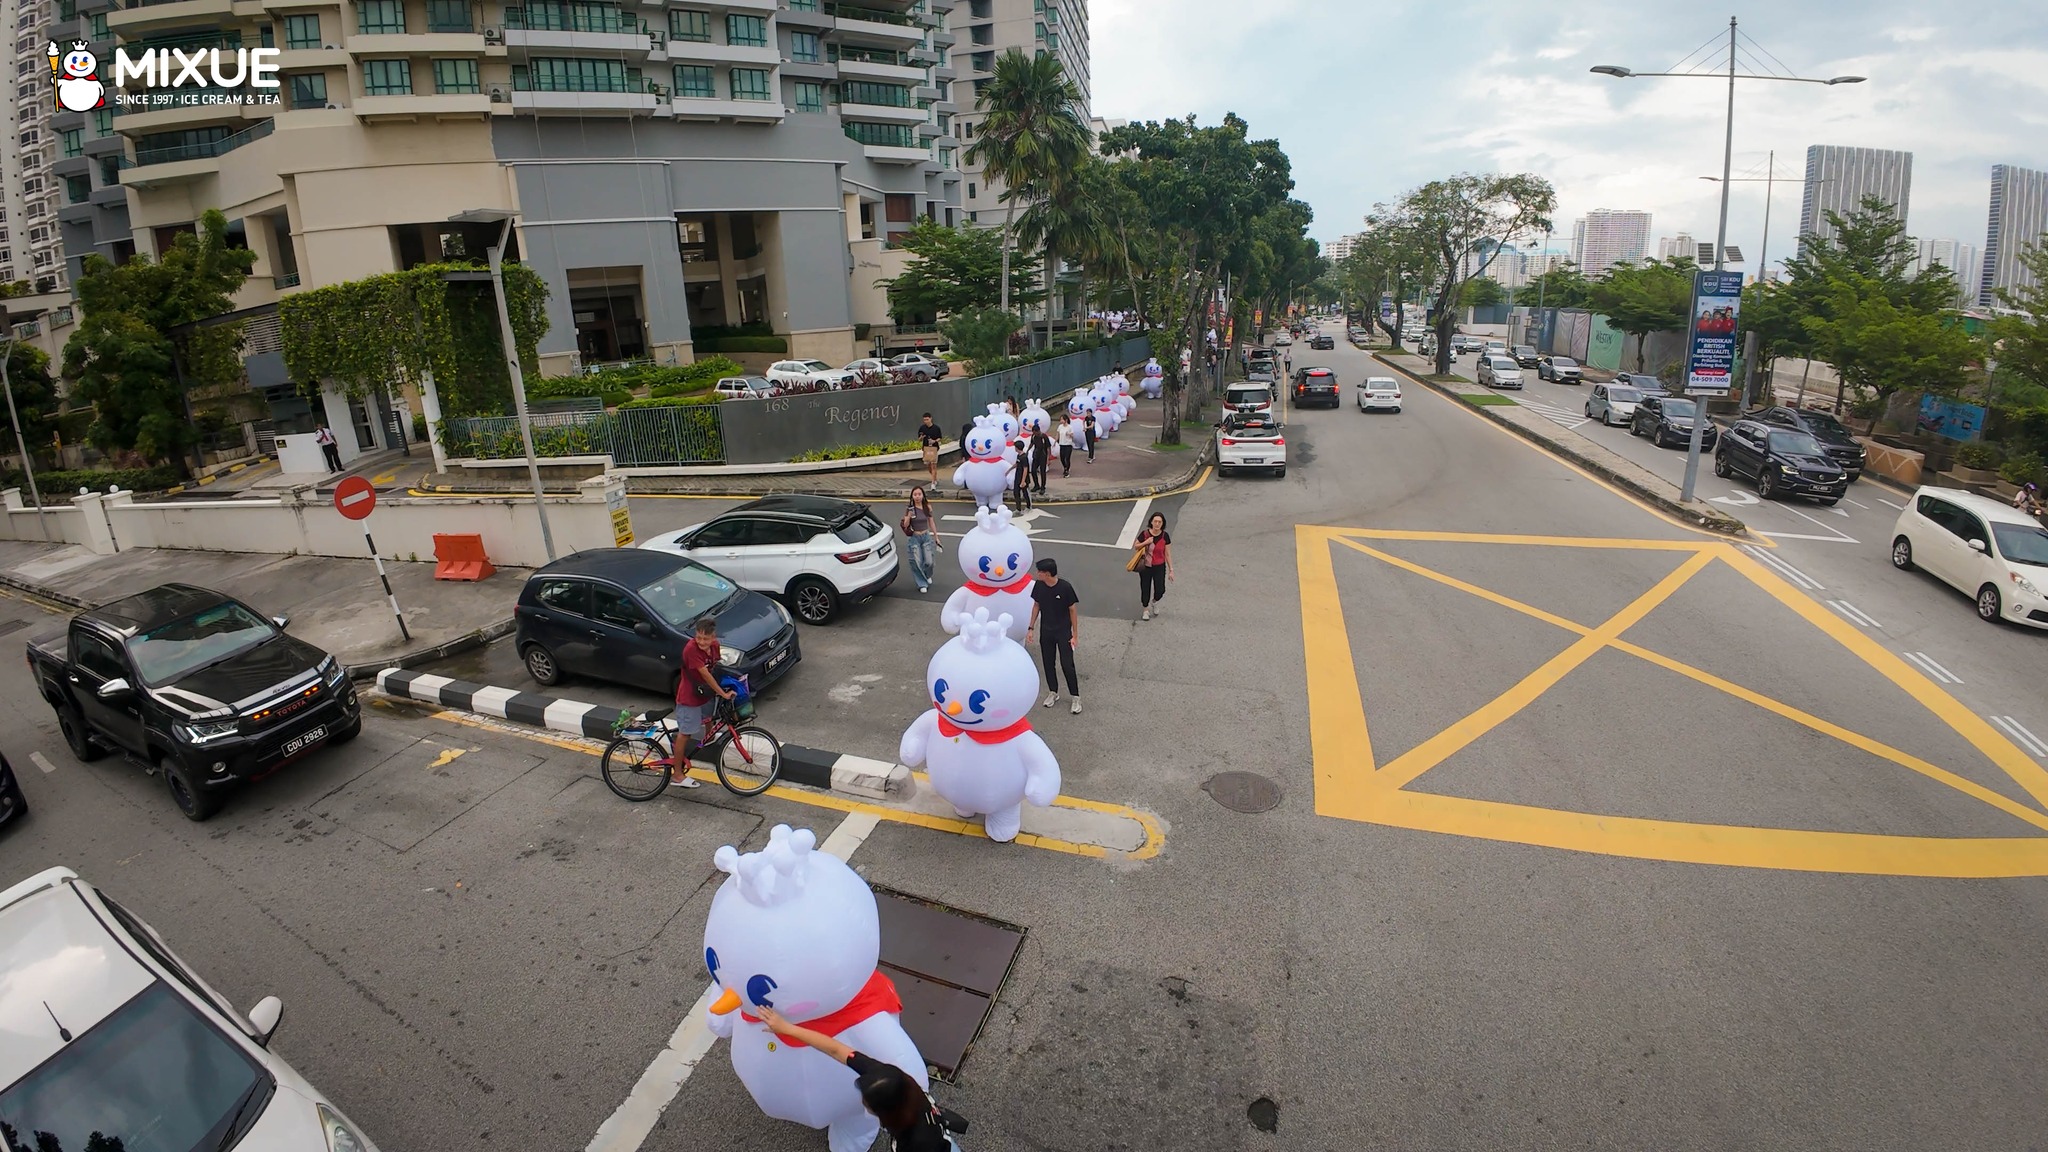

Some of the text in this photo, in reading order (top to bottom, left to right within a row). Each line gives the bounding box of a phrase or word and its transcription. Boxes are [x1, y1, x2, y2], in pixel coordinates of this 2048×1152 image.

[764, 397, 790, 413] 168
[807, 399, 820, 409] The
[824, 404, 901, 431] Regency
[277, 700, 307, 716] TOYOTA
[287, 728, 323, 752] CDU 2926
